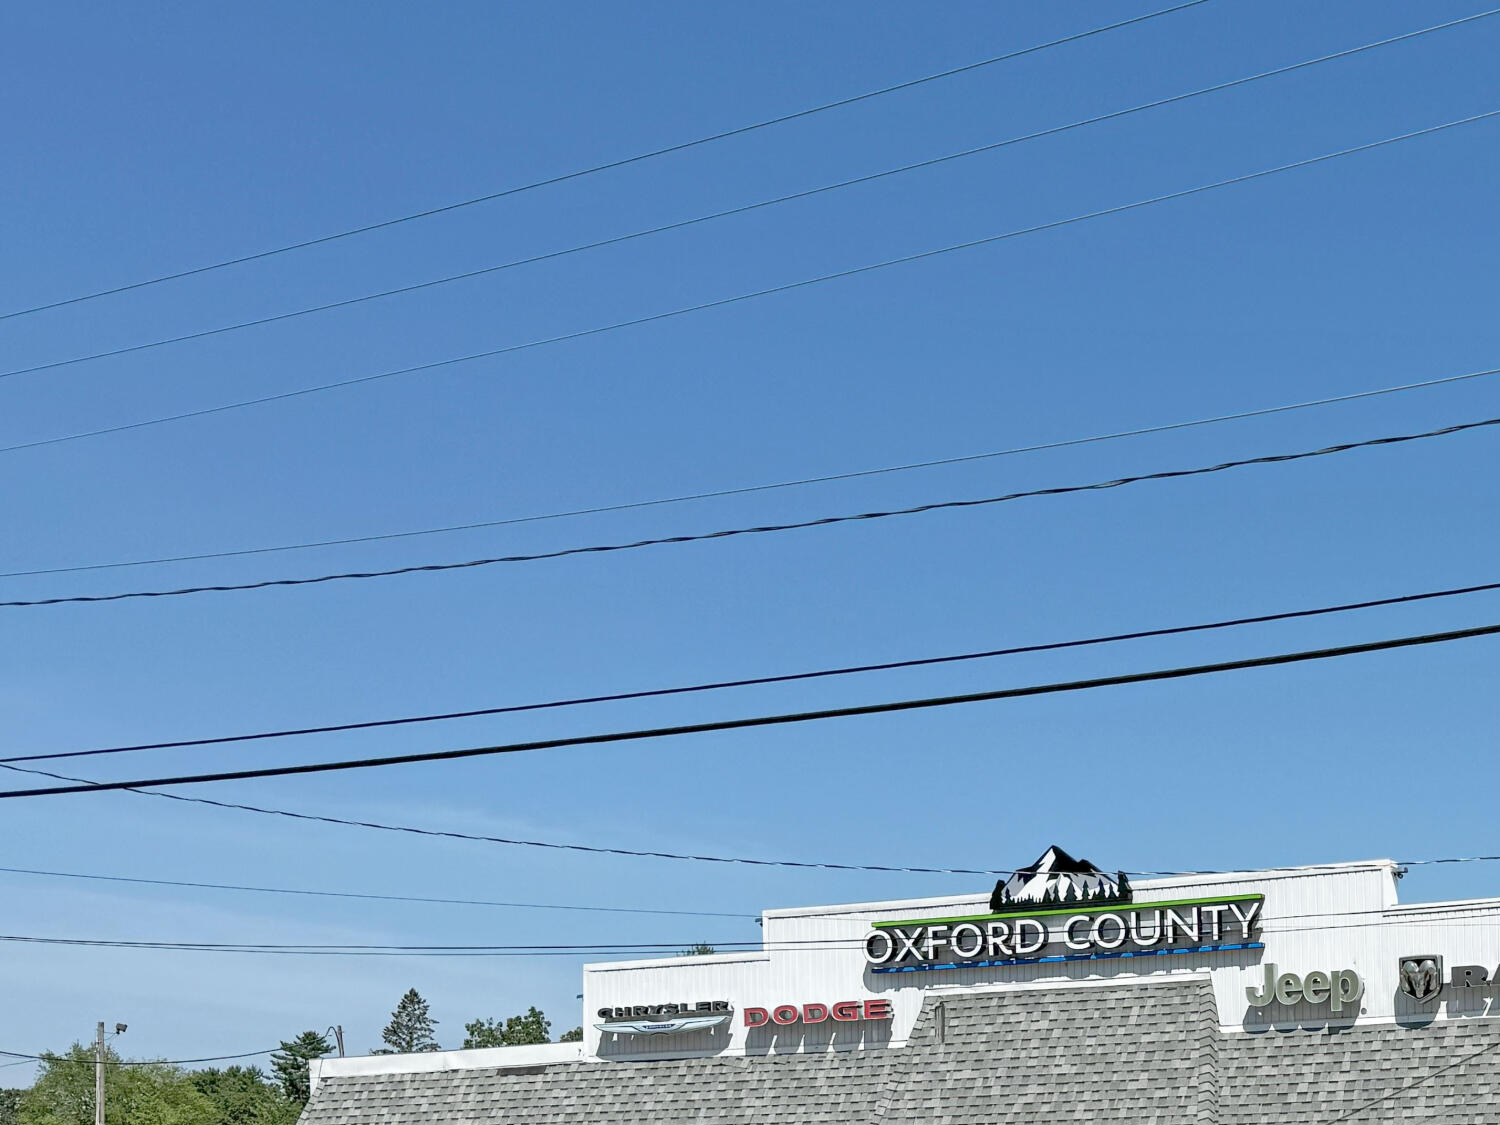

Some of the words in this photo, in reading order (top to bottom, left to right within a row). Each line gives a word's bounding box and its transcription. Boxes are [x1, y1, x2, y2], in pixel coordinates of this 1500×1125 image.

[862, 918, 1045, 964] OXFORD
[1063, 902, 1260, 950] COUNTY
[1246, 963, 1361, 1012] Jeep
[597, 1000, 730, 1019] CHRYSLER
[743, 999, 893, 1027] DODGE
